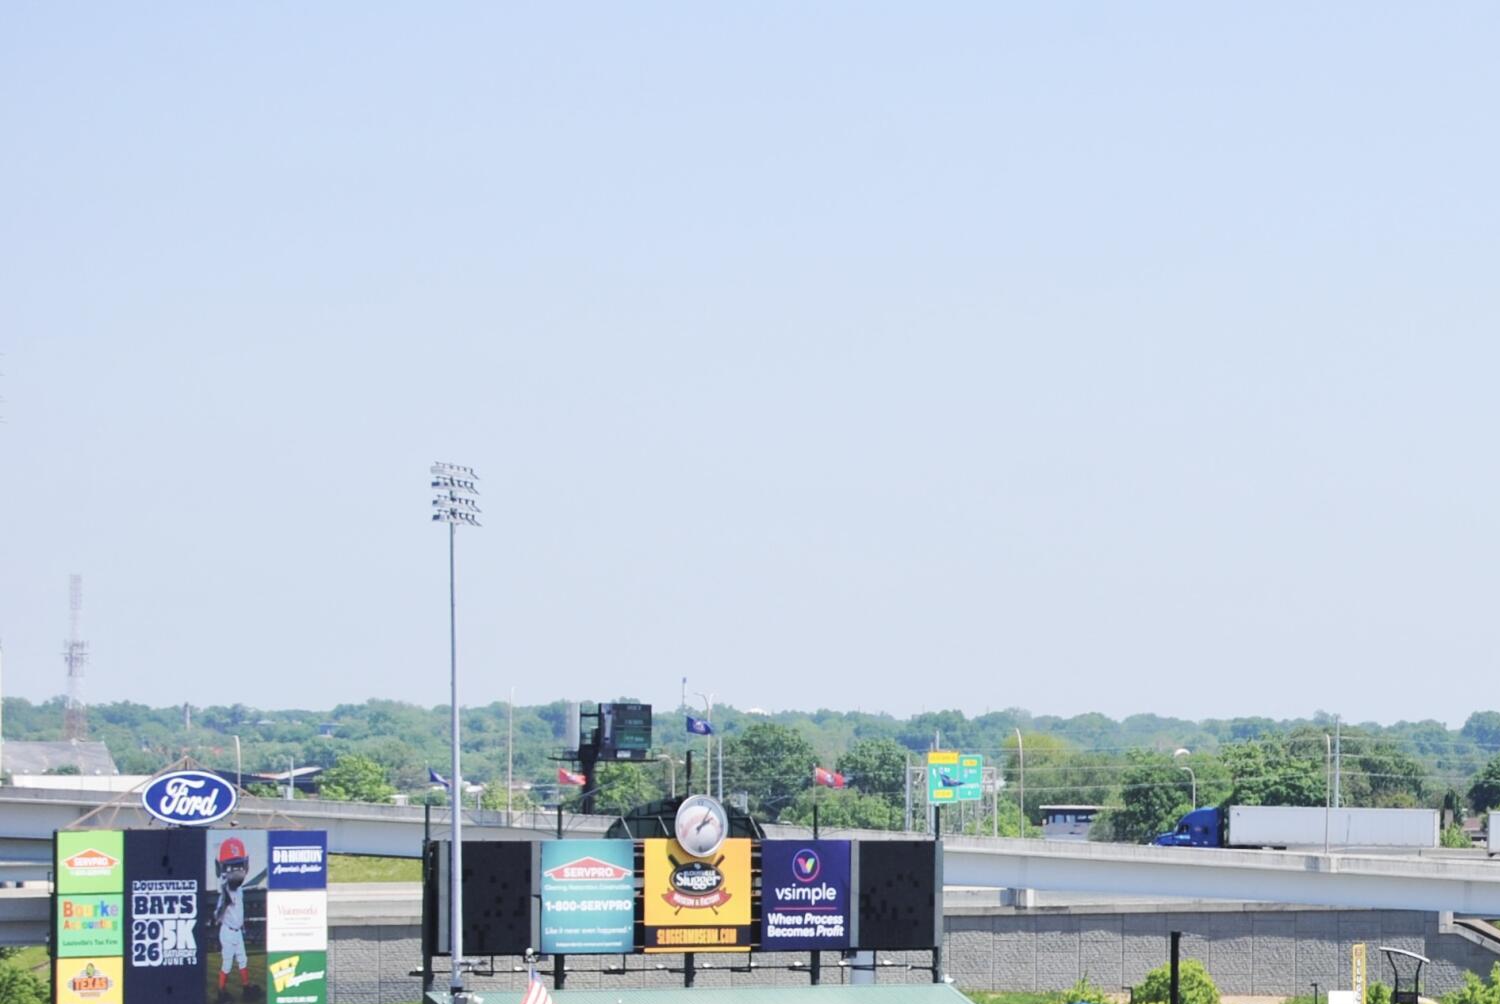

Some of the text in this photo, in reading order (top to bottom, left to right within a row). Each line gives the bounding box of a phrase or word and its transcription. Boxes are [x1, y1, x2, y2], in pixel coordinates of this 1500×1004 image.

[160, 778, 219, 816] Ford
[133, 881, 195, 891] LOUISVILLE
[676, 872, 721, 890] Slugger
[775, 882, 837, 906] vsimple
[64, 901, 119, 917] Bourke
[134, 895, 194, 915] BATS
[545, 900, 632, 911] 1-800-SERVPRO
[767, 913, 844, 925] Where Process
[134, 921, 160, 940] 20
[163, 920, 197, 949] 5K
[767, 925, 844, 937] Becomes Profit
[134, 943, 160, 962] 26
[163, 957, 184, 966] JUNE
